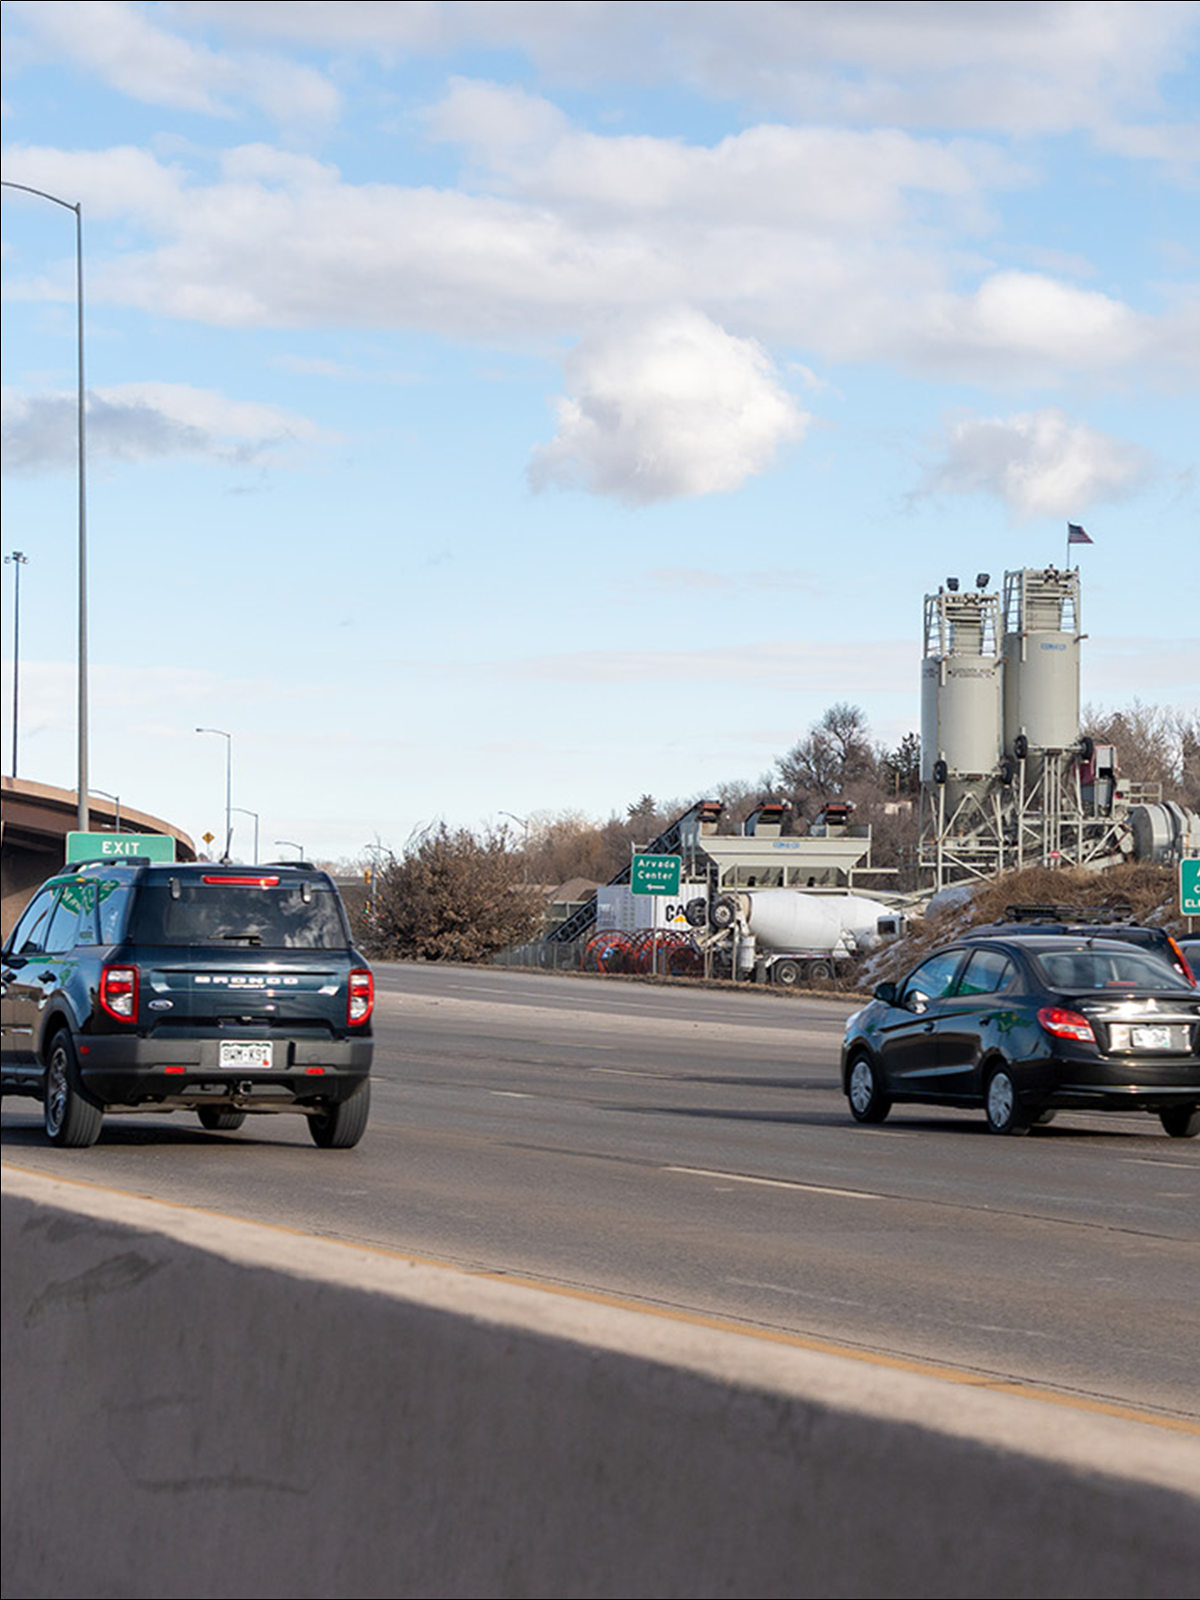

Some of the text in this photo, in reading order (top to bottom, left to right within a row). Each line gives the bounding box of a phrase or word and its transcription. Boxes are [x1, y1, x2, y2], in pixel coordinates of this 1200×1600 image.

[102, 841, 140, 855] EXIT
[637, 859, 675, 869] Arvada
[637, 870, 673, 879] Center
[194, 976, 299, 985] BRONCO
